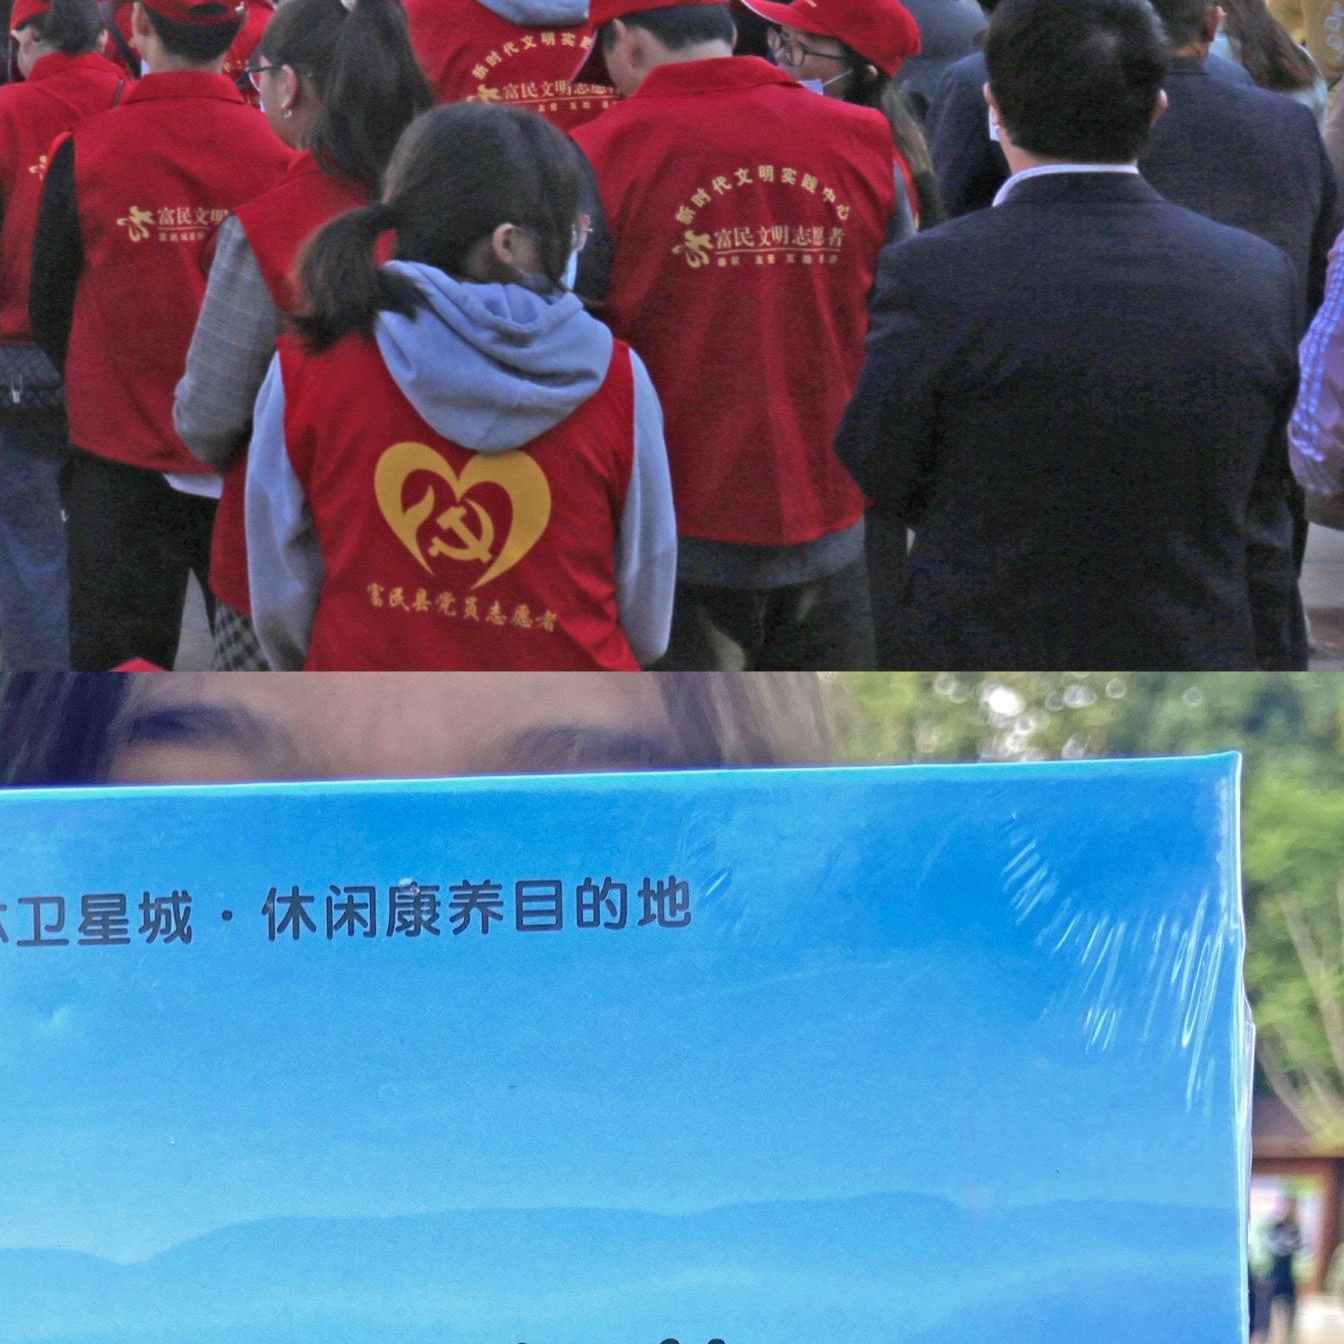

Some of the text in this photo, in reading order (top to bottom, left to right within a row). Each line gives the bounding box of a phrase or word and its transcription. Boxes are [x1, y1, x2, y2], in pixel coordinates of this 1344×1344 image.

[675, 165, 850, 225] 新时代文明实践中心
[366, 582, 559, 633] 富民县党员志愿者
